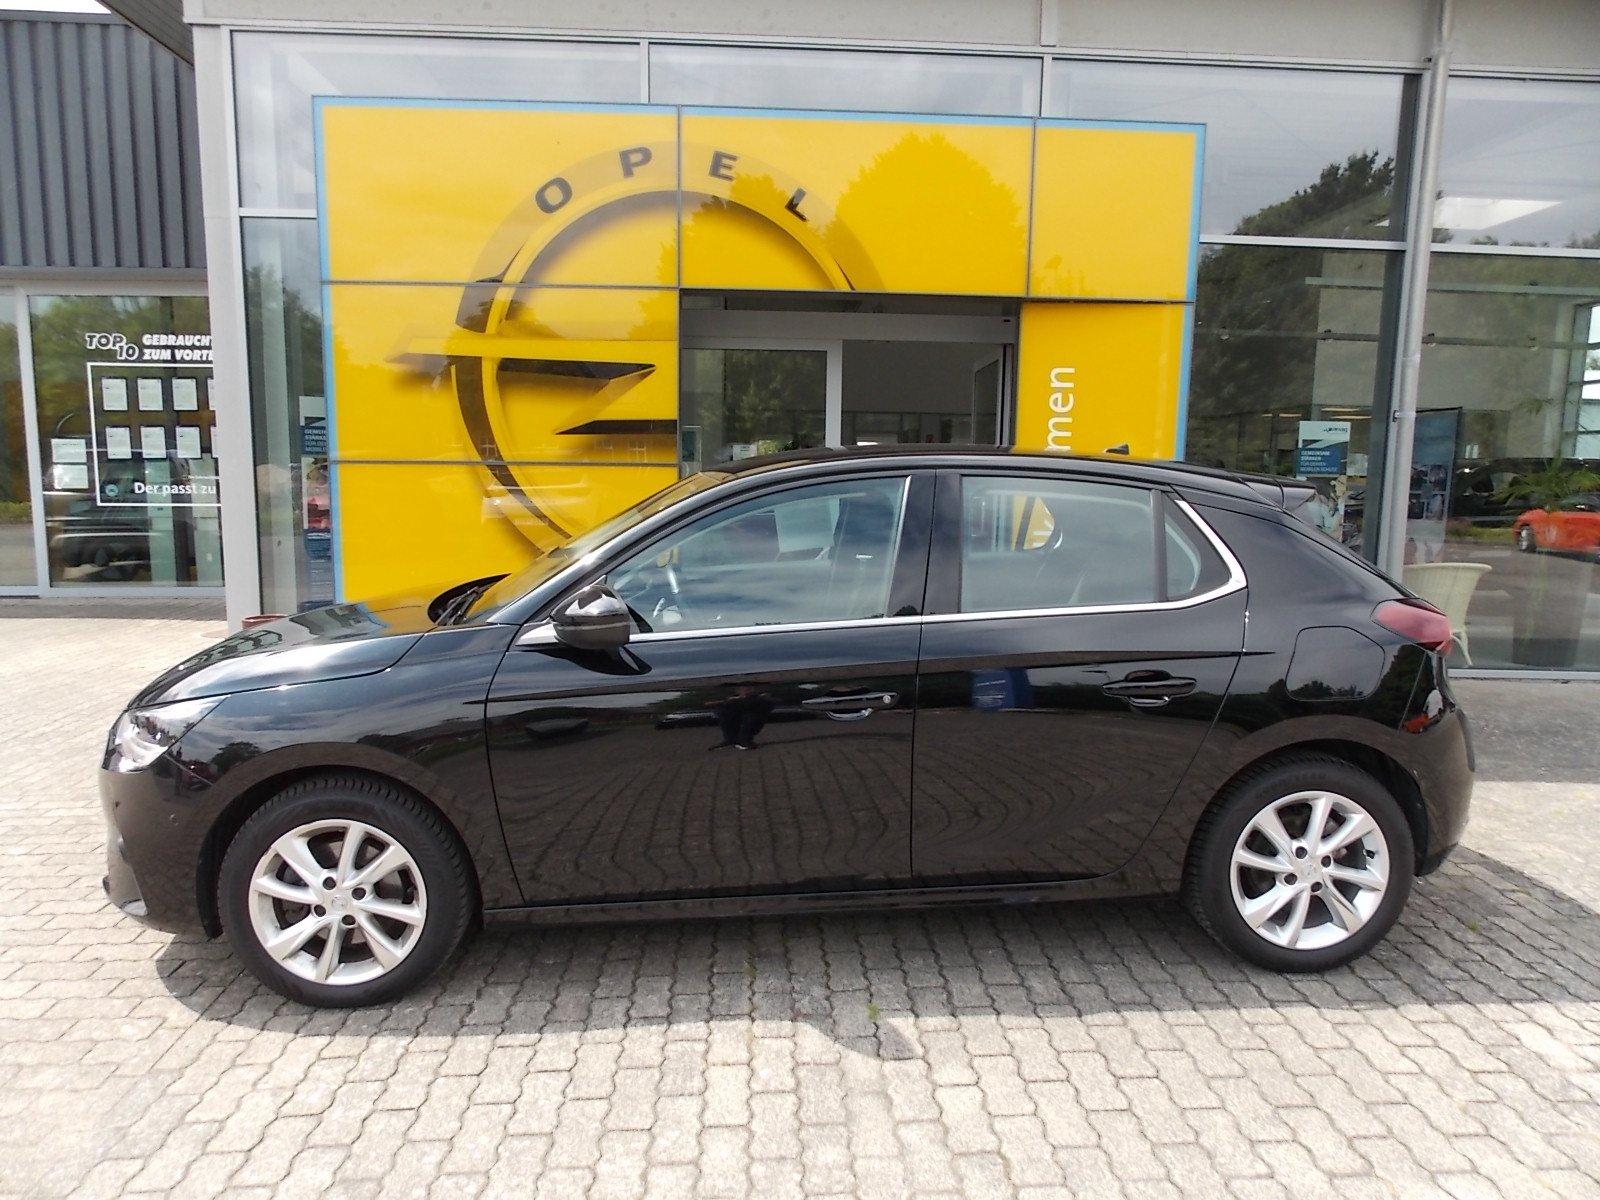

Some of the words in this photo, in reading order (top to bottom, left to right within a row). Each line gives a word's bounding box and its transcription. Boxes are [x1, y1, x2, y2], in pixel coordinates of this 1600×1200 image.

[534, 146, 808, 223] OPEL
[85, 332, 126, 350] TOP
[117, 343, 139, 361] 10
[142, 348, 172, 361] ZUM
[1045, 366, 1075, 451] men
[133, 481, 158, 494] Der
[162, 483, 197, 497] passt
